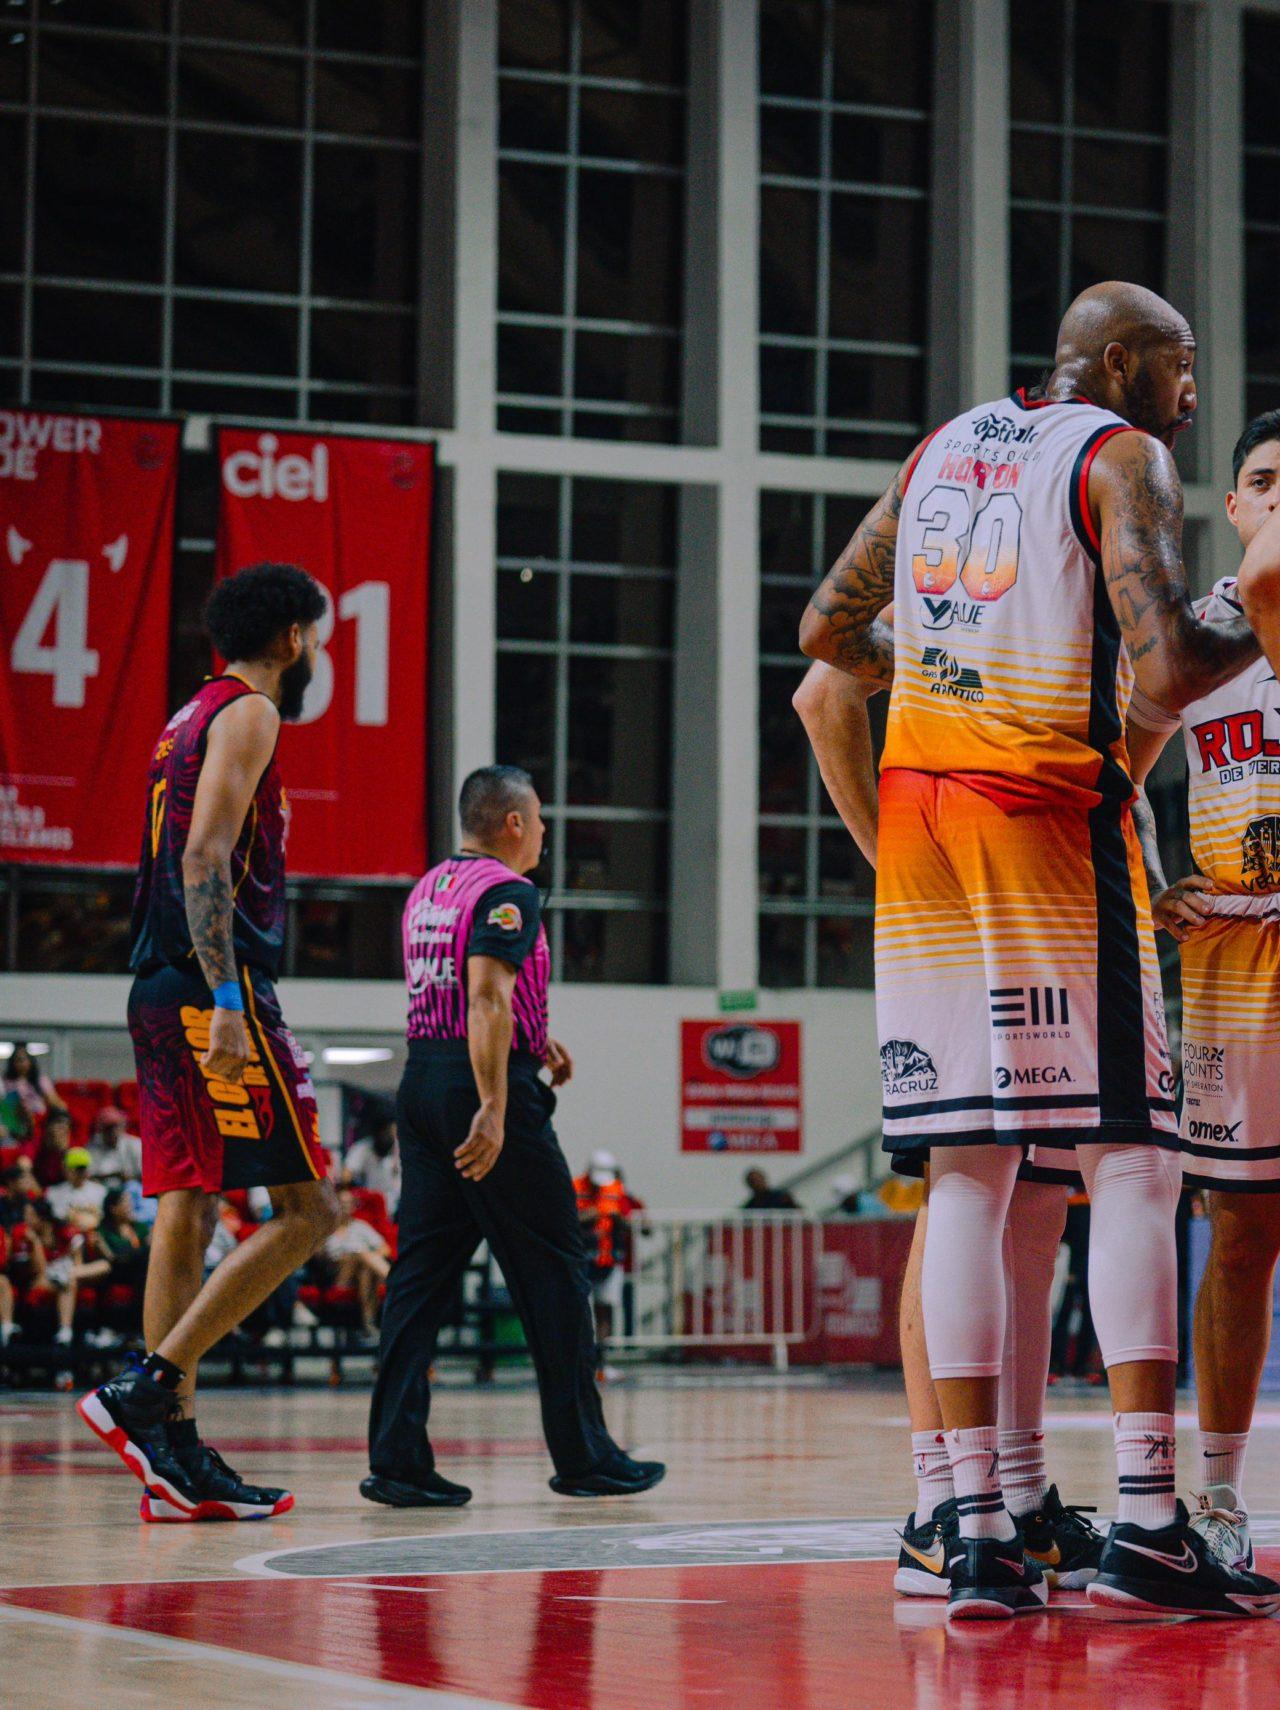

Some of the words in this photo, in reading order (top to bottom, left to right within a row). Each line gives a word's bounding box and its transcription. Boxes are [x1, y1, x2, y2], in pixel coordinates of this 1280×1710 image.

[222, 433, 328, 502] ciel
[911, 485, 1023, 602] 30
[11, 559, 99, 709] 4
[930, 682, 985, 703] ANTICO
[1219, 766, 1244, 785] DE
[1183, 1043, 1210, 1062] FOUR
[1183, 1060, 1224, 1081] POINTS
[883, 1078, 938, 1096] RACRUZ
[1188, 1118, 1243, 1143] omex
